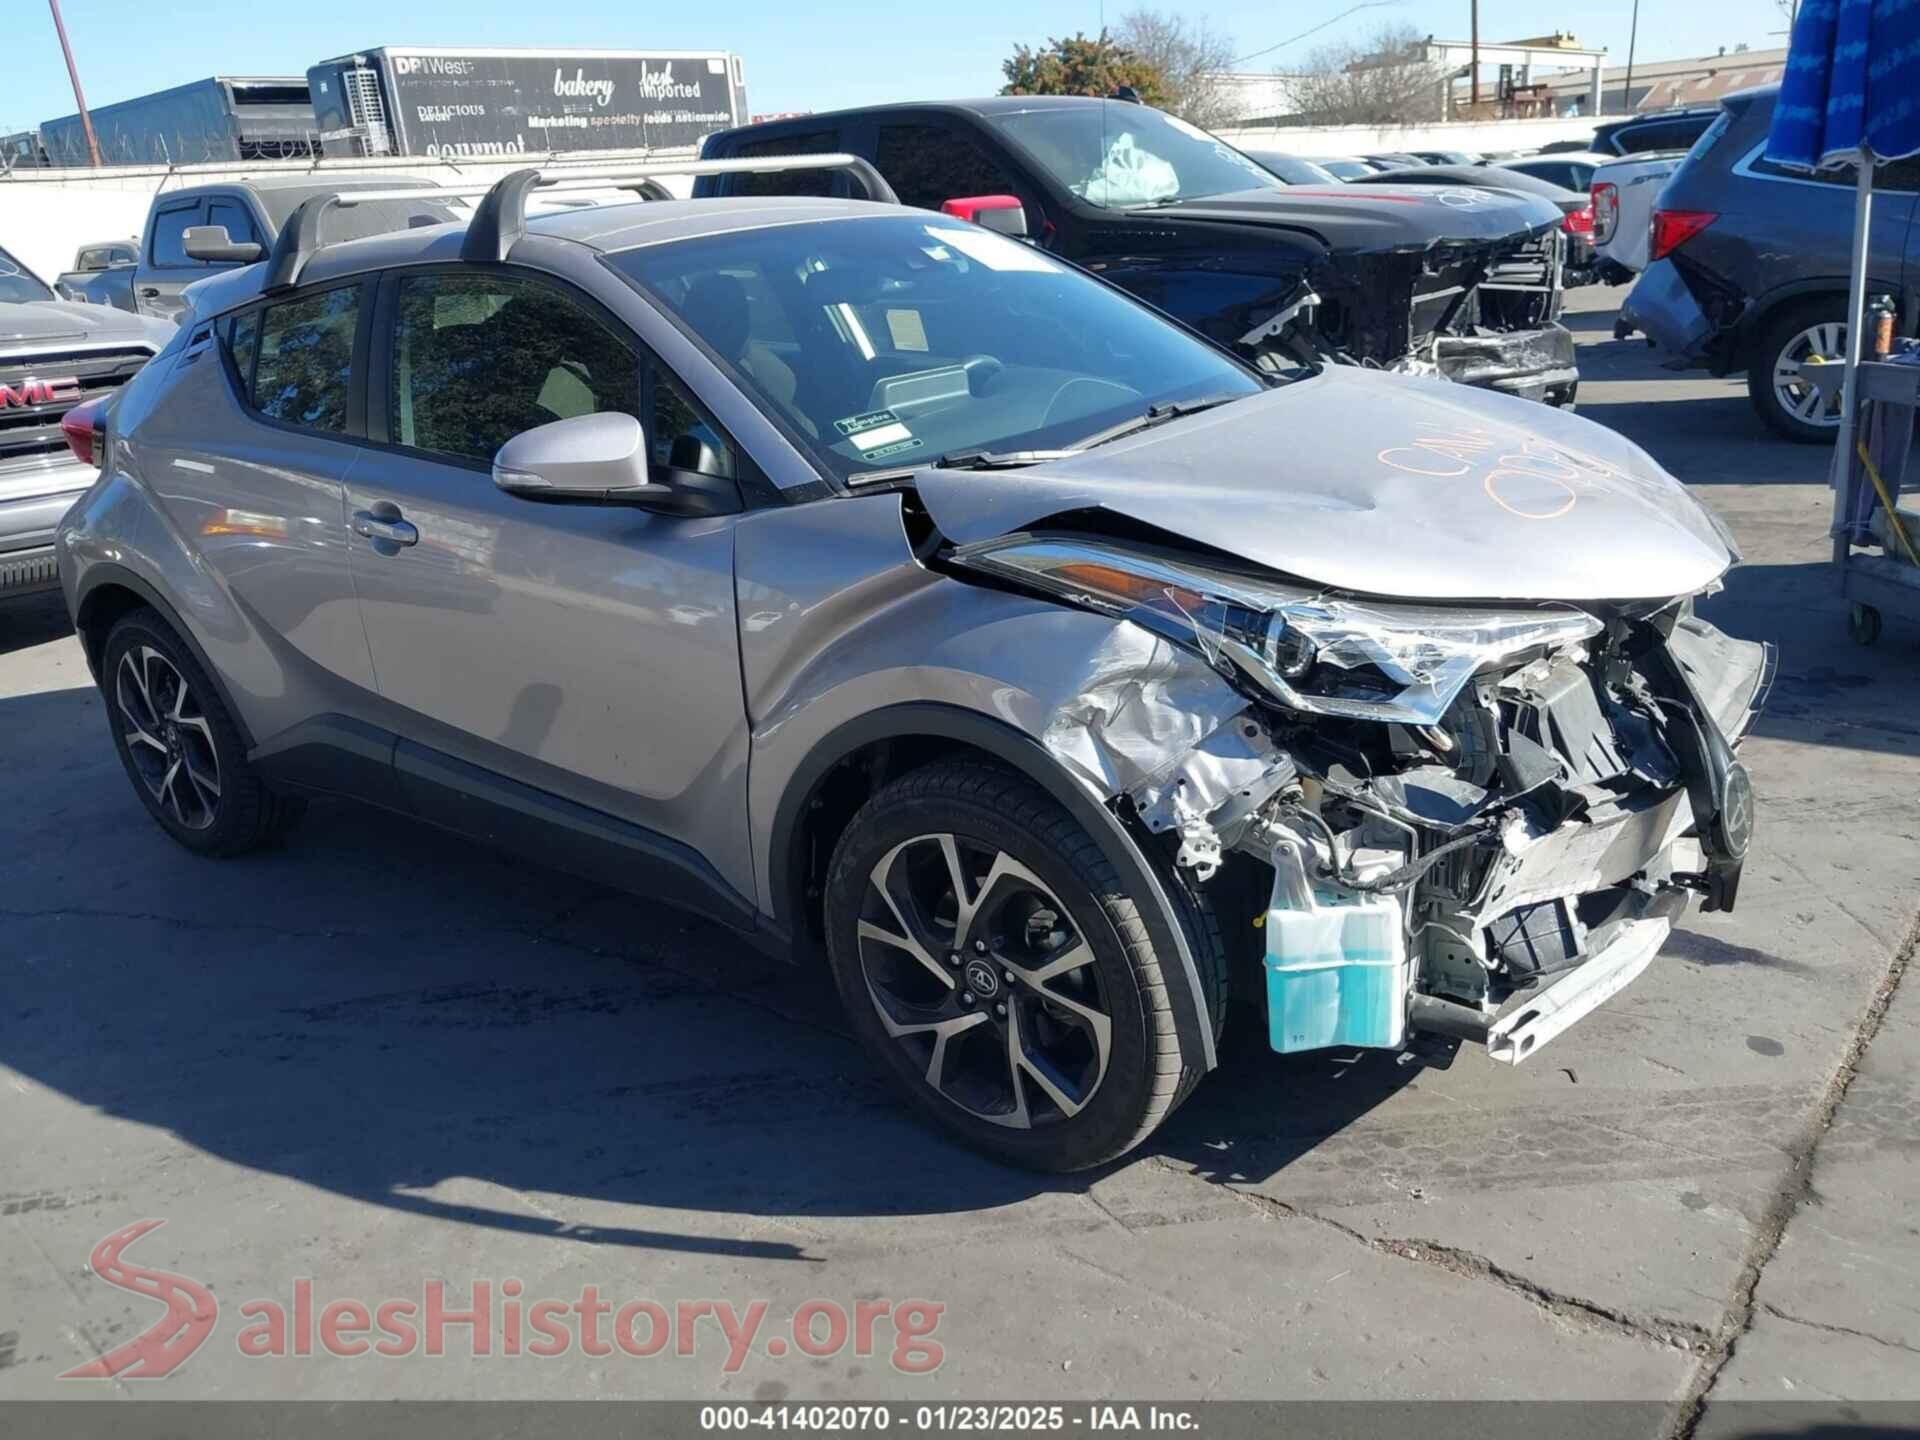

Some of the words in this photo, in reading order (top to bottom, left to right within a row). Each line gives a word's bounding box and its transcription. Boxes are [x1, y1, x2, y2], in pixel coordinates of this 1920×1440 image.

[553, 68, 615, 107] bakery
[639, 81, 701, 101] imported
[416, 104, 486, 118] DELICIOUS
[527, 115, 588, 129] Marketing
[590, 114, 641, 126] specialty
[643, 112, 673, 124] foods
[674, 111, 731, 123] nationwide
[0, 376, 80, 406] MC
